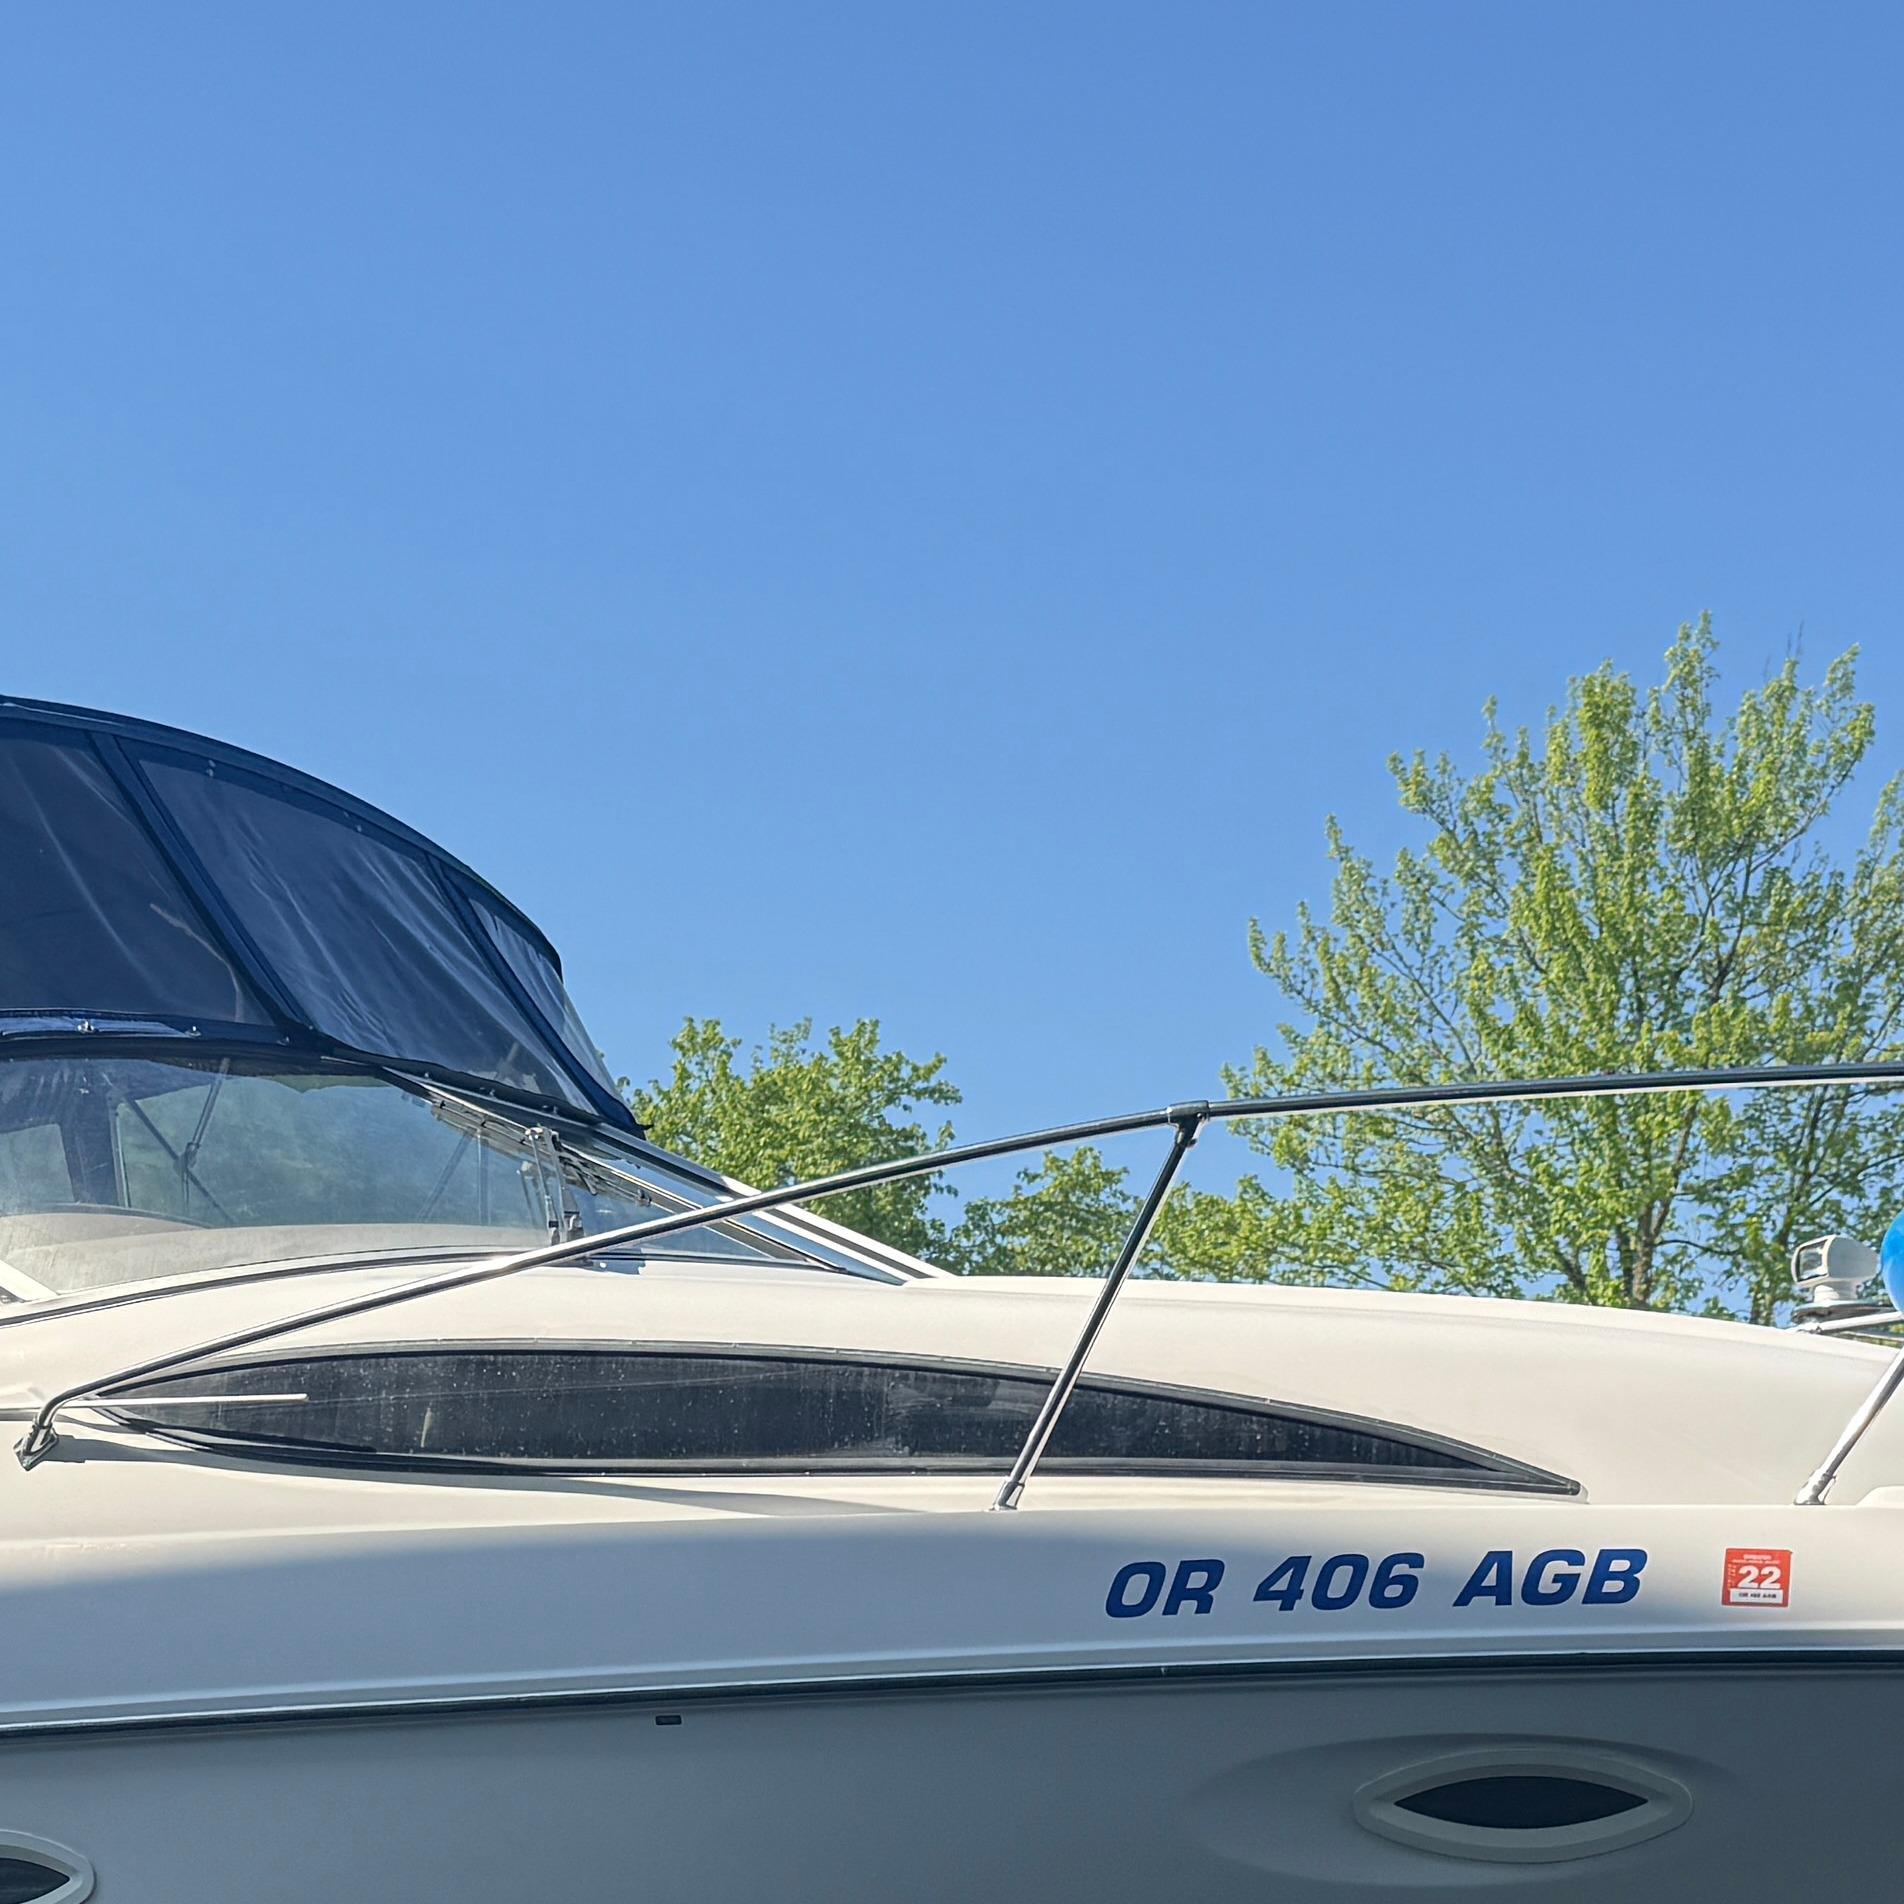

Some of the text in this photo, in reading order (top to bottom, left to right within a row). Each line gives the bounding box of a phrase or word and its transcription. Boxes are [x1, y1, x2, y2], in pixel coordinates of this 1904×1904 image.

[1105, 1547, 1648, 1618] OR 406 AGB
[1737, 1565, 1782, 1589] 22
